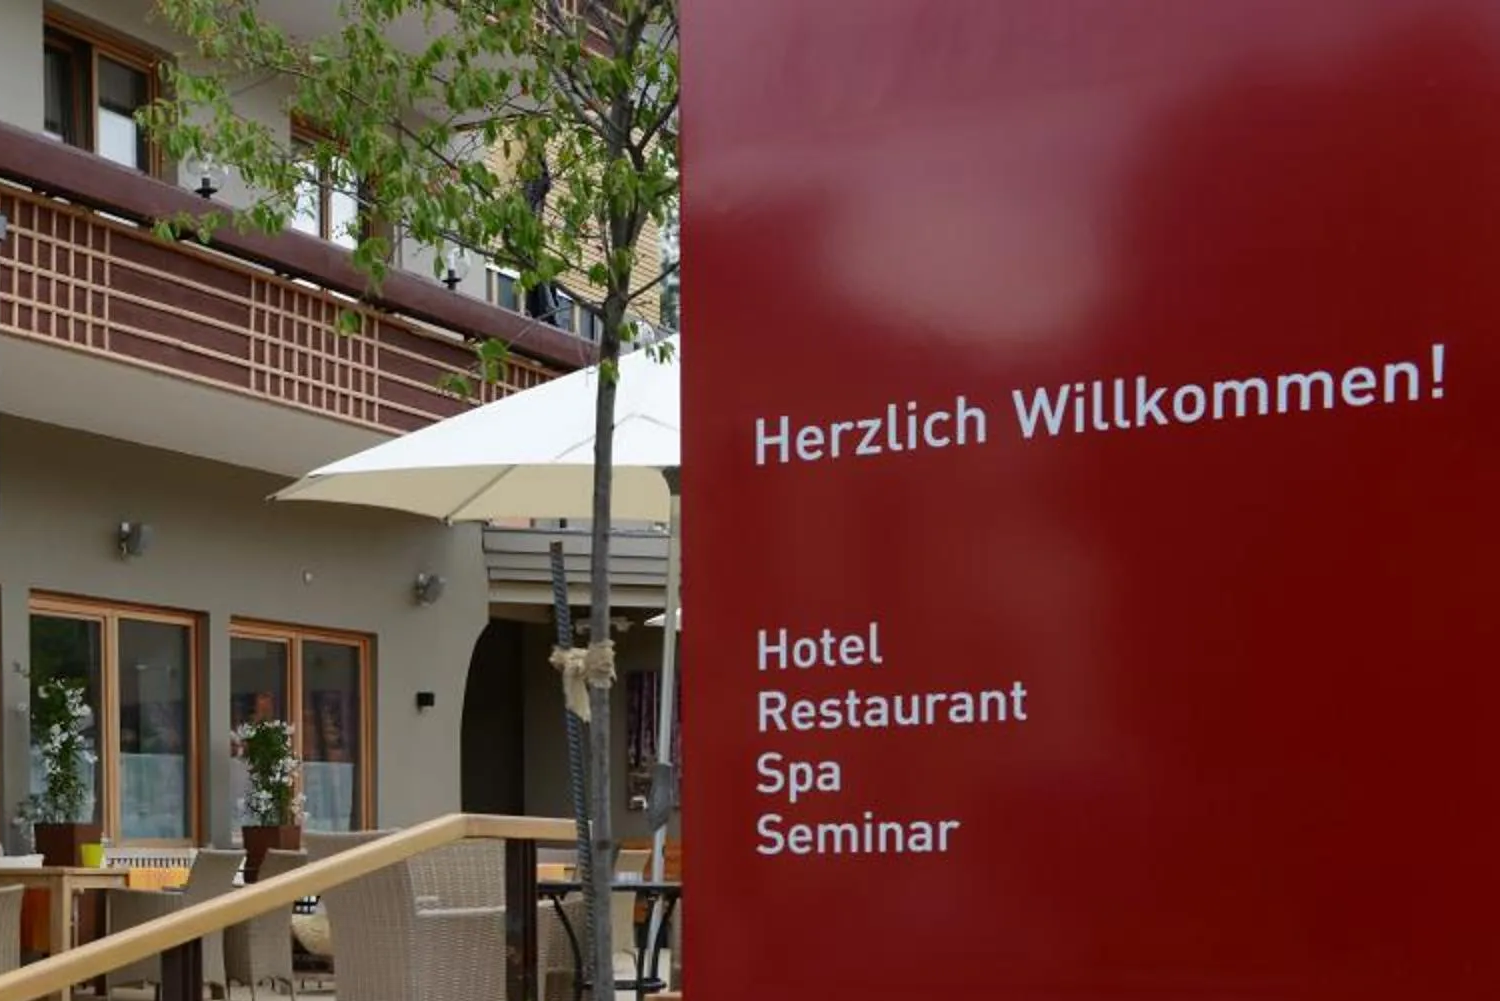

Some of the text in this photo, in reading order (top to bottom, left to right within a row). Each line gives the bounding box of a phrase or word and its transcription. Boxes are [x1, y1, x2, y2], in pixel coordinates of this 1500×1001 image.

[755, 344, 1445, 465] Herzlich Willkommen!
[757, 622, 883, 671] Hotel
[757, 681, 1027, 732] Restaurant
[756, 752, 841, 803] Spa
[756, 811, 960, 855] Seminar
